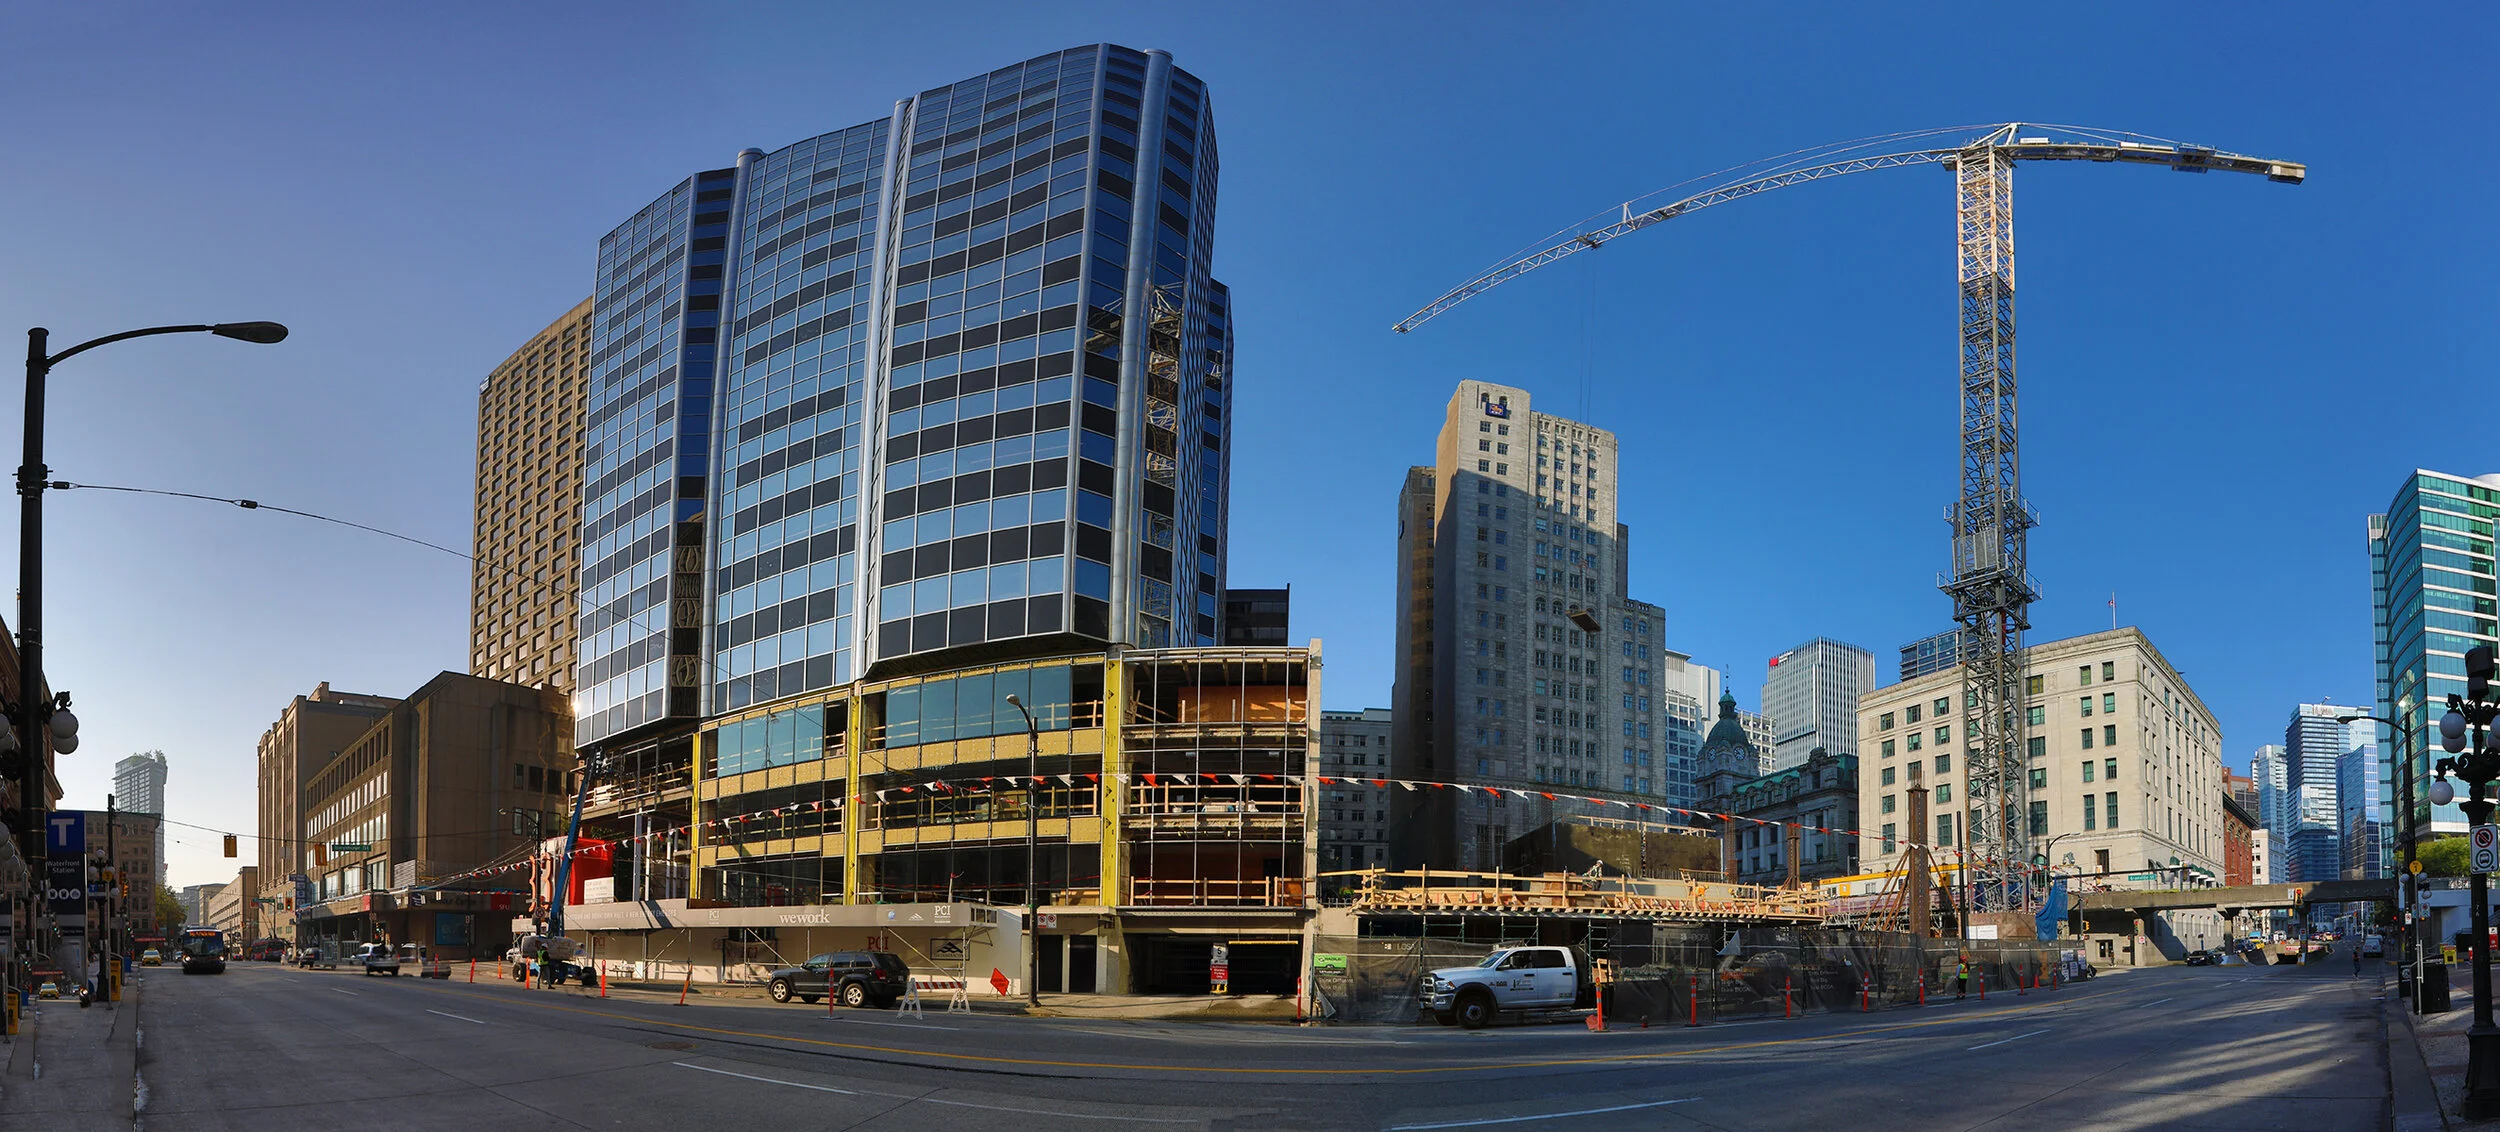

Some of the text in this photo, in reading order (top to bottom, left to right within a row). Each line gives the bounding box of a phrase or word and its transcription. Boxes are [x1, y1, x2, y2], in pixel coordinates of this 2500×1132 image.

[51, 818, 75, 846] T
[708, 910, 720, 920] PCI
[779, 908, 830, 924] wework
[934, 904, 951, 916] PCI
[867, 936, 889, 950] PCI
[1217, 947, 1223, 955] 5
